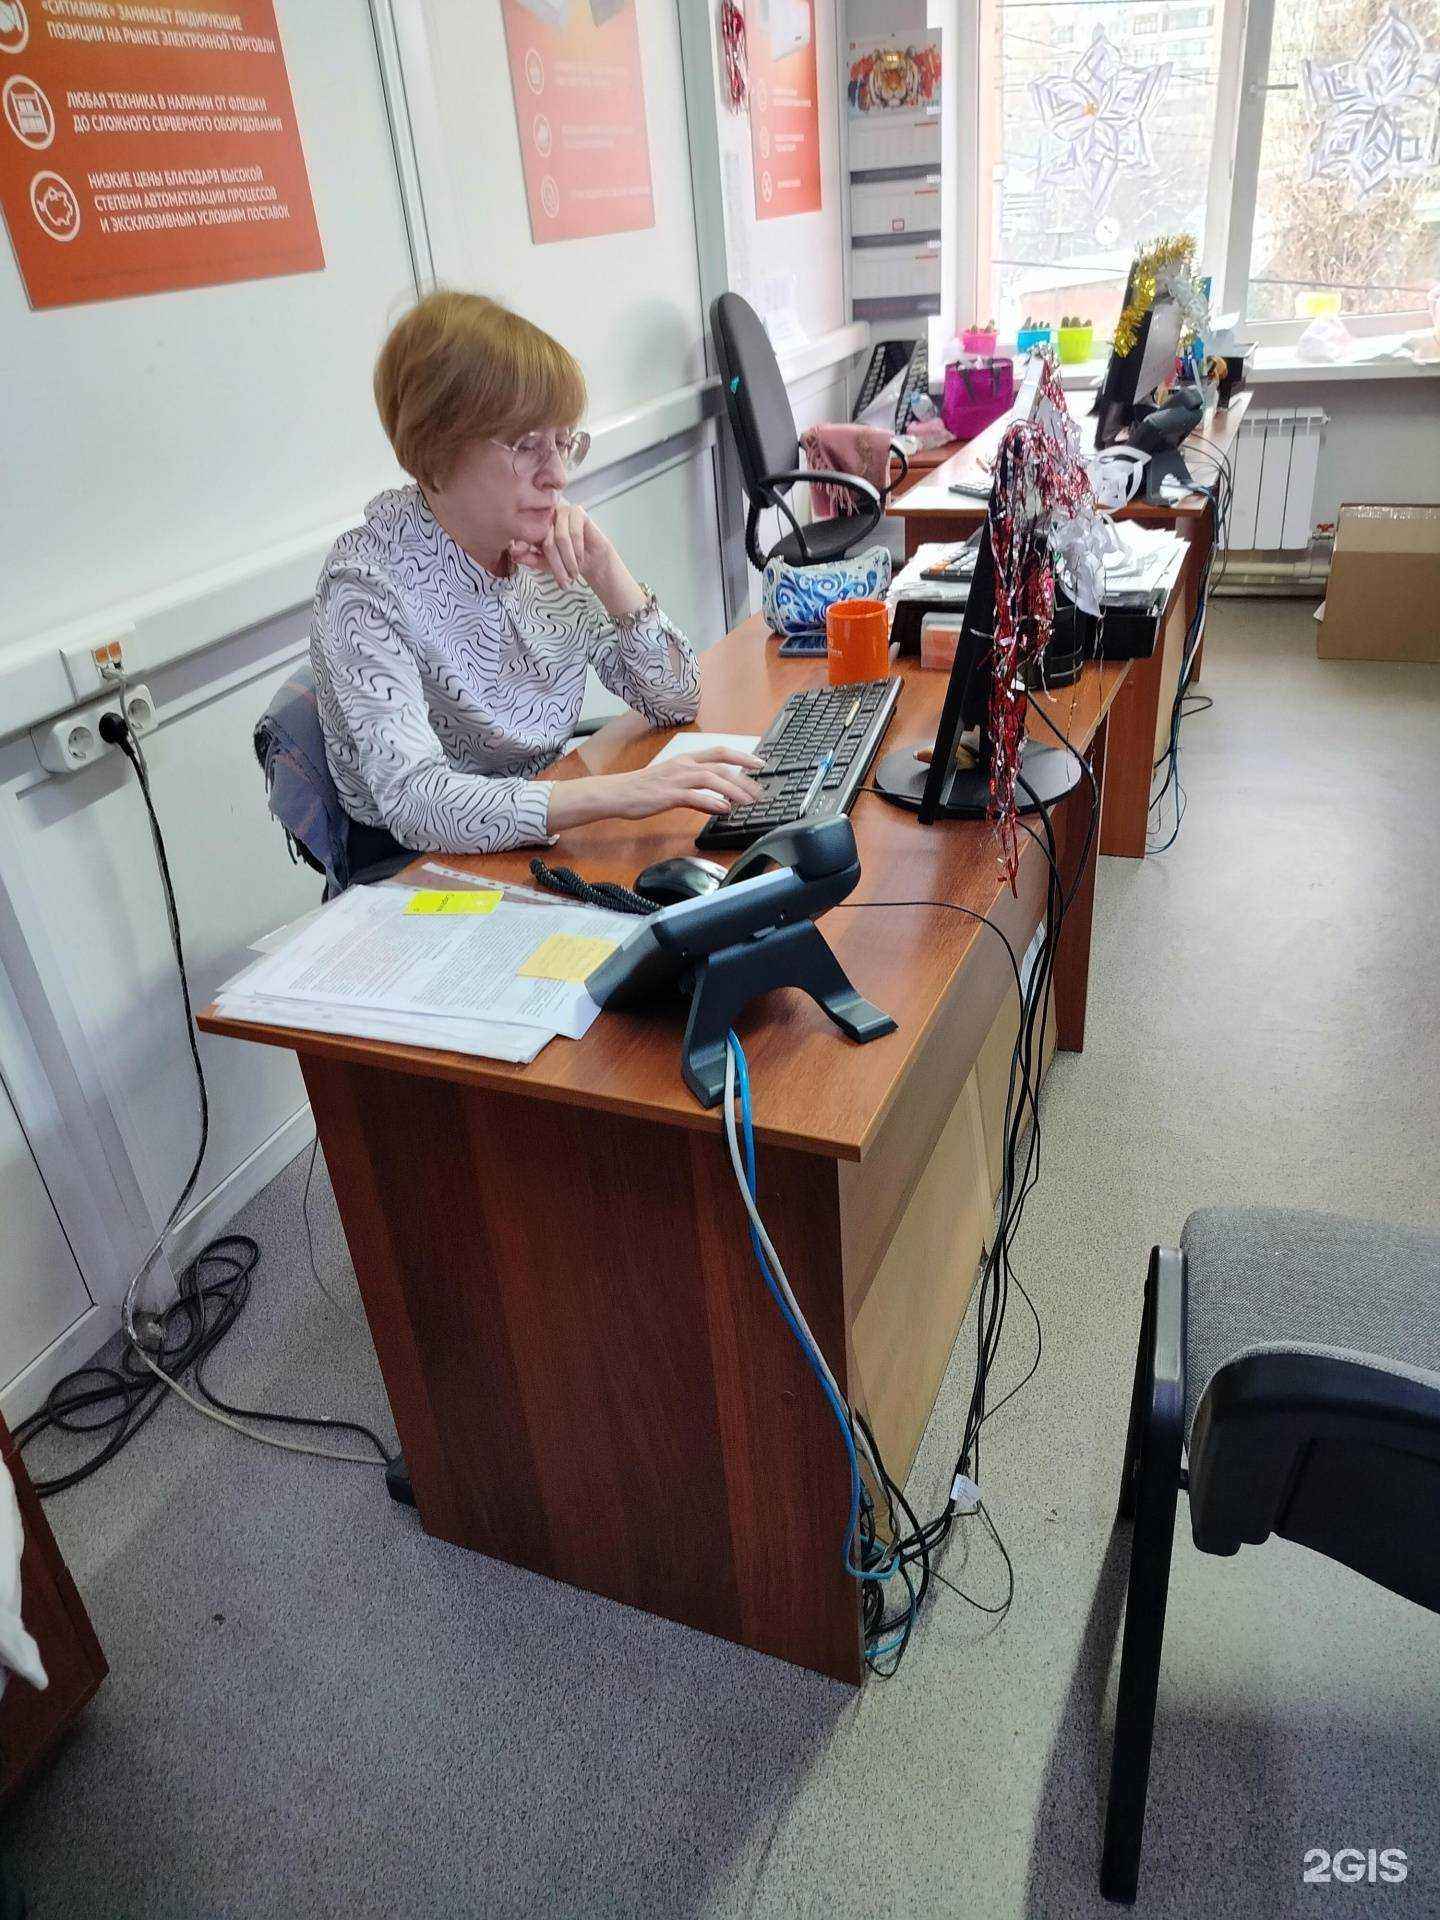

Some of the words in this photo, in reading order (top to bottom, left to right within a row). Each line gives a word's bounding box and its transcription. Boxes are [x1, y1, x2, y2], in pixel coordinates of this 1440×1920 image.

[46, 20, 106, 42] ПОЗИЦИИ
[106, 26, 124, 43] НА
[123, 27, 160, 47] РЫНКЕ
[160, 30, 231, 51] ЭЛЕКТРОННОЙ
[230, 35, 276, 54] ТОРГОВЛИ
[66, 90, 108, 109] ЛЮБАЯ
[107, 91, 159, 110] ТЕХНИКА
[157, 93, 167, 110] В
[167, 94, 215, 111] НАЛИЧИИ
[214, 94, 227, 111] ОТ
[73, 114, 90, 134] ДО
[91, 114, 151, 132] СЛОЖНОГО
[152, 114, 213, 132] СЕРВЕРНОГО
[213, 116, 283, 134] ОБОРУДОВАНИЯ
[87, 171, 133, 189] НИЗКИЕ
[132, 170, 164, 189] ЦЕНЫ
[163, 167, 220, 186] БЛАГОДАРЯ
[220, 164, 264, 184] ВЫСОКОЙ
[94, 193, 143, 212] СТЕПЕНИ
[143, 189, 227, 209] АВТОМАТИЗАЦИИ
[227, 185, 278, 203] ПРОЦЕССОВ
[99, 217, 111, 233] И
[110, 211, 197, 233] ЭКСКЛЮЗИВНЫМ
[196, 207, 246, 226] УСЛОВИЯМ
[246, 204, 291, 222] ПОСТАВОК
